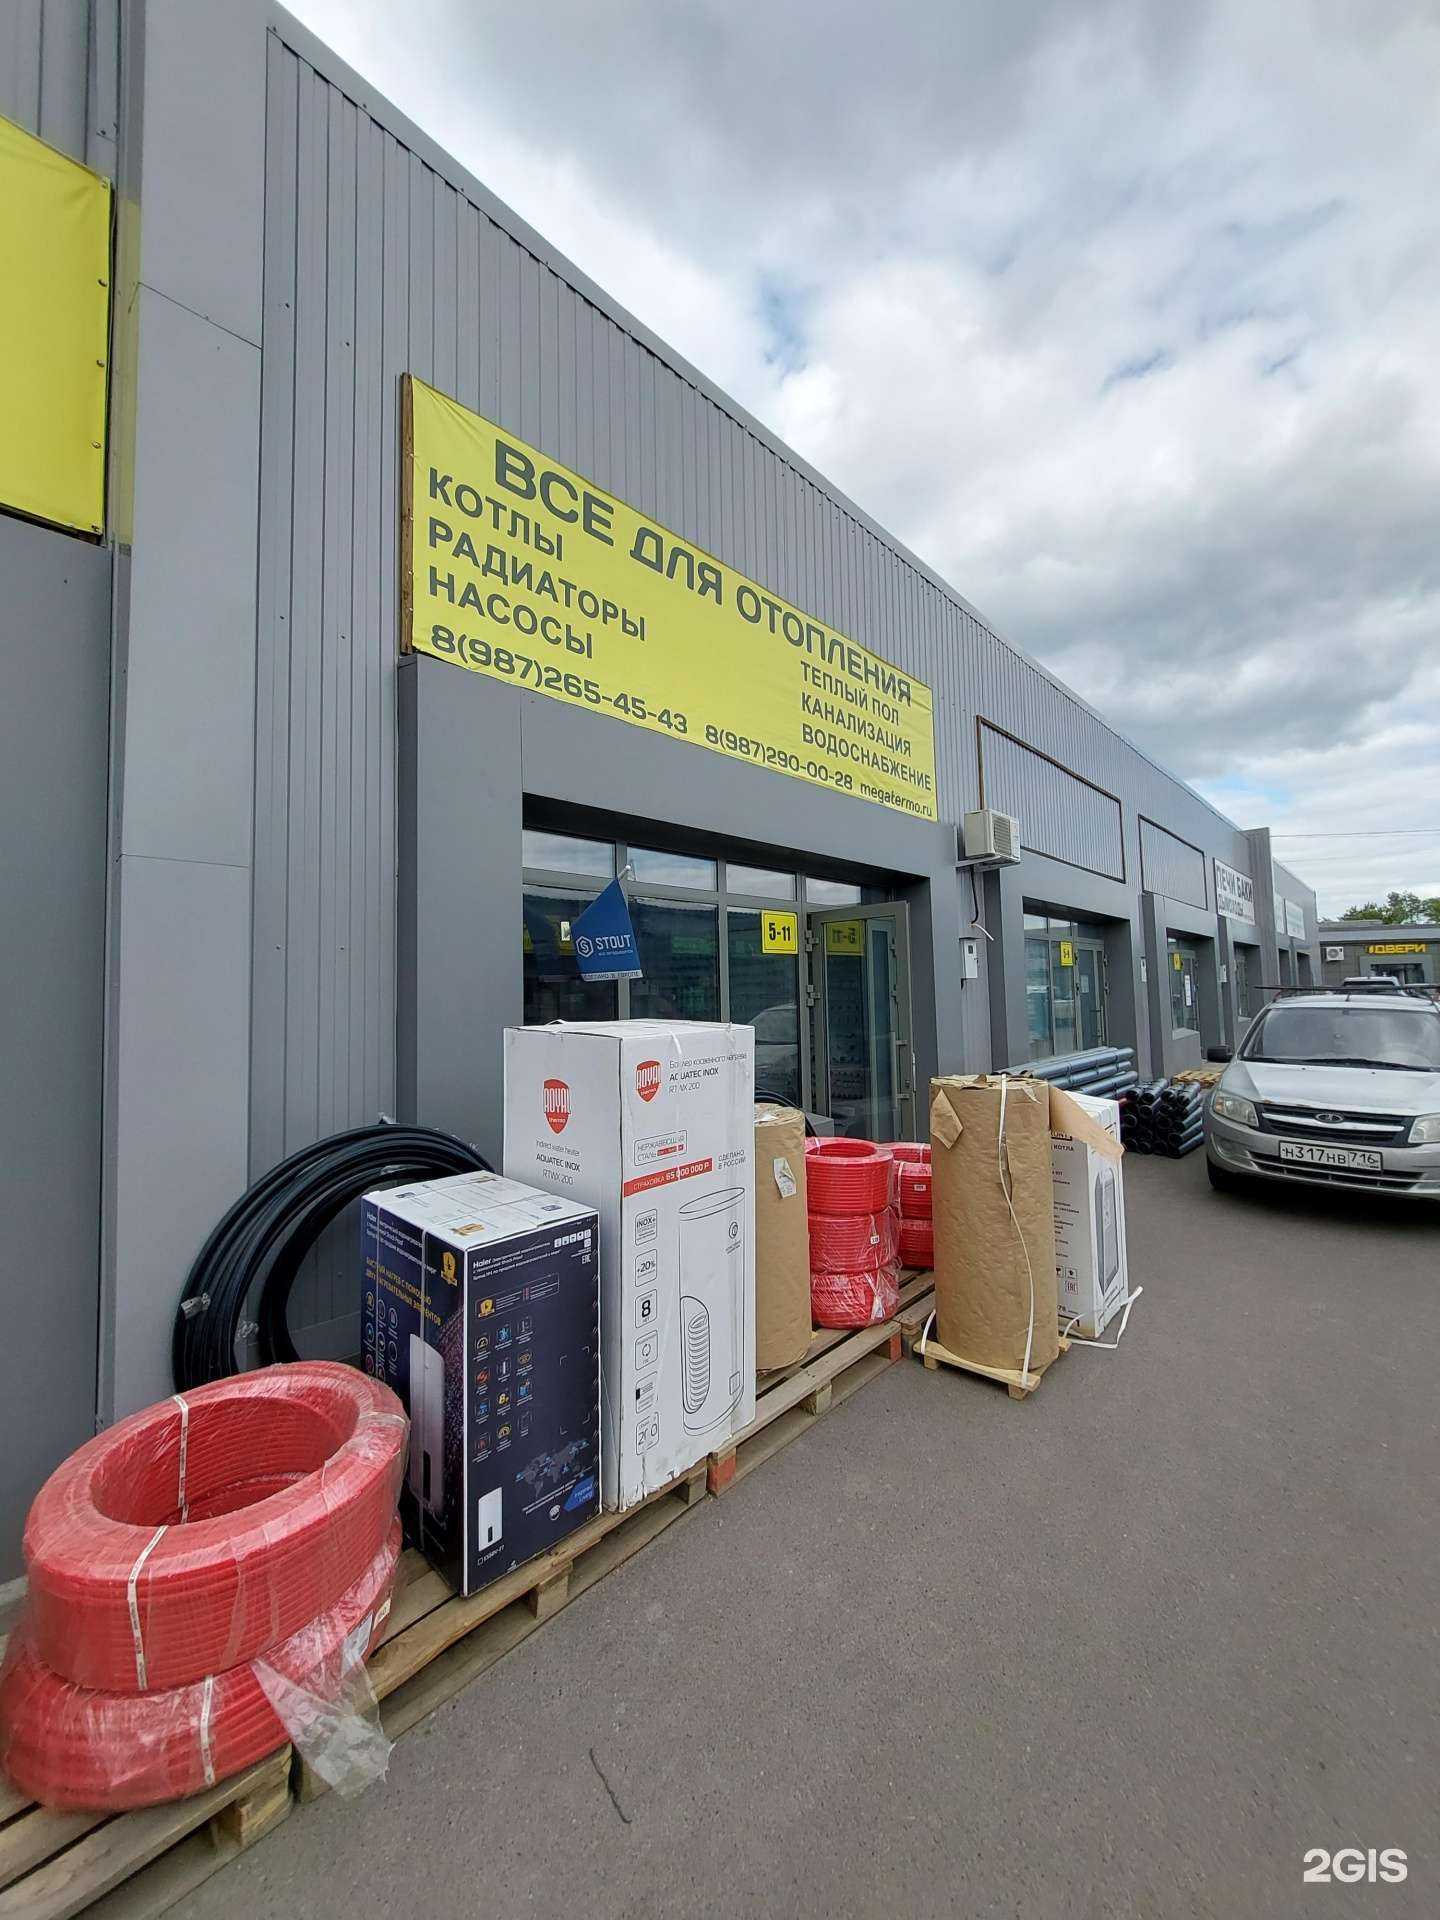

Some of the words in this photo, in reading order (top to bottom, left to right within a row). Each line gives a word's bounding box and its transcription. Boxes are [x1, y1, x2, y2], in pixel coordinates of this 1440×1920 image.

[429, 467, 563, 562] КОТЛЫ
[429, 516, 645, 641] РАДИАТОРЫ
[495, 440, 615, 547] ВСЕ
[630, 526, 722, 606] ДЛЯ
[736, 584, 912, 707] ОТОПЛЕНИЯ
[429, 566, 593, 659] НАСОСЫ
[801, 660, 868, 711] ТЕПЛЫЙ
[872, 697, 900, 726] ПОЛ
[431, 624, 688, 735] 8(987)265-45-43
[705, 725, 853, 791] 8(987)290-00-28
[860, 782, 932, 817] megatermo.ru
[801, 691, 912, 757] КАНАЛИЗАЦИЯ
[802, 722, 932, 791] ВОДОСНАБЖЕНИЕ
[595, 934, 631, 951] STOUT
[768, 922, 791, 942] 5-11
[1374, 943, 1426, 954] ДВЕРИ
[702, 1067, 719, 1078] INOX
[536, 1152, 564, 1168] AQUATEC
[564, 1159, 581, 1173] INOX
[1349, 1151, 1377, 1164] 716
[473, 1257, 491, 1269] Haier
[641, 1299, 651, 1318] 8
